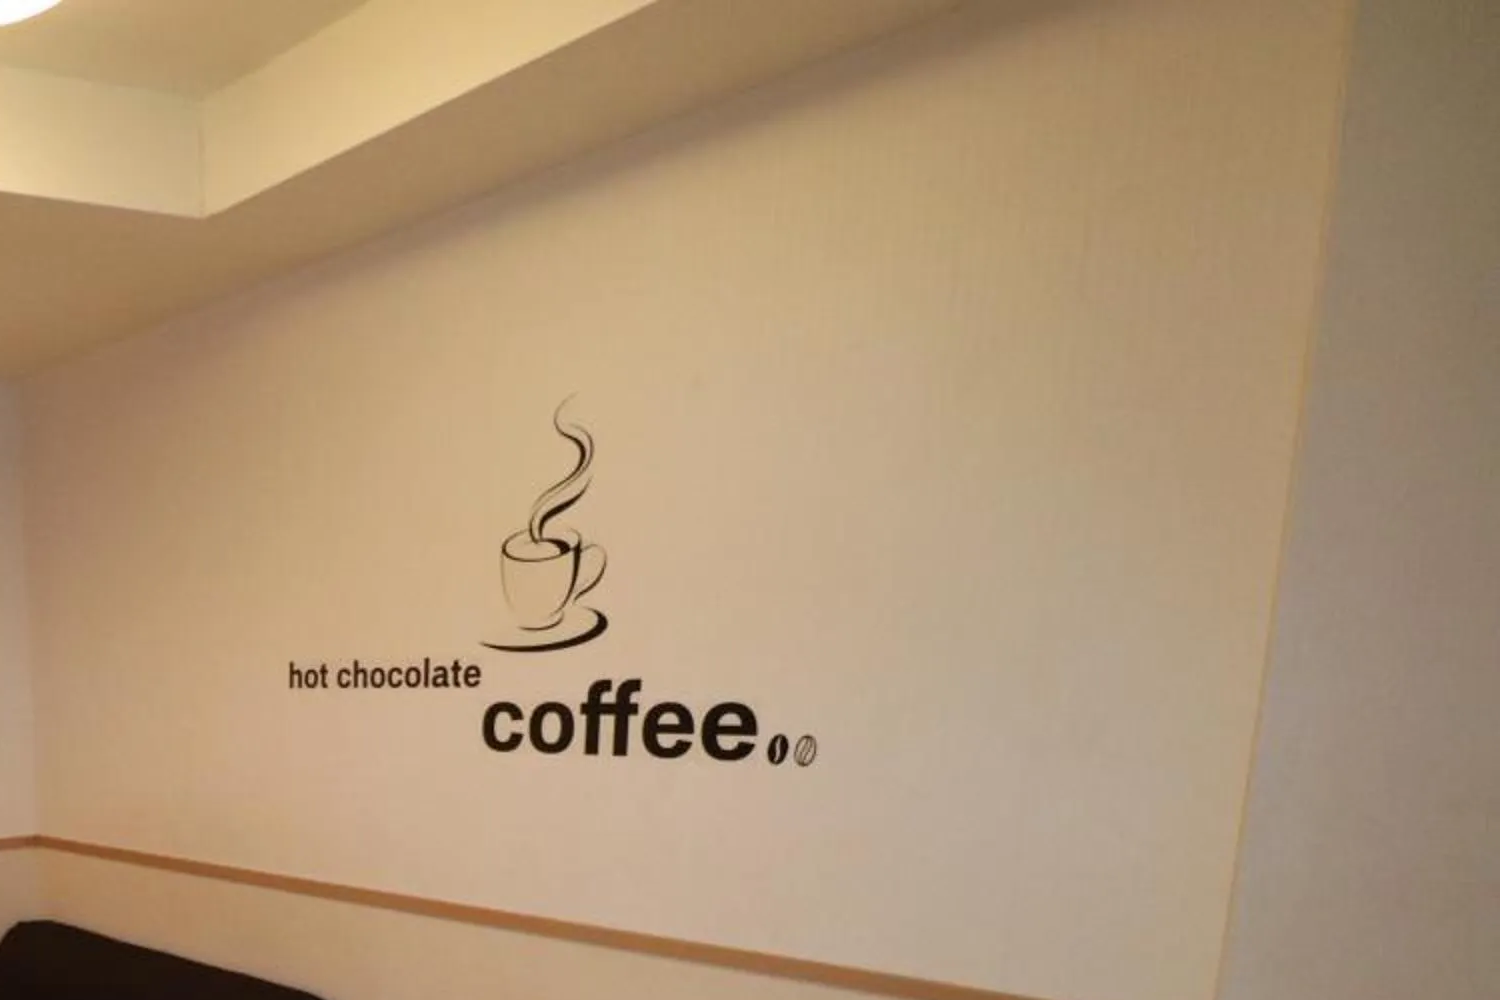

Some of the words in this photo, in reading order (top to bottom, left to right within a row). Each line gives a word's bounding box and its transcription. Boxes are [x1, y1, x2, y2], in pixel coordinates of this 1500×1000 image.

[289, 660, 329, 689] hot
[336, 657, 482, 689] chocolate
[482, 678, 758, 762] coffee
